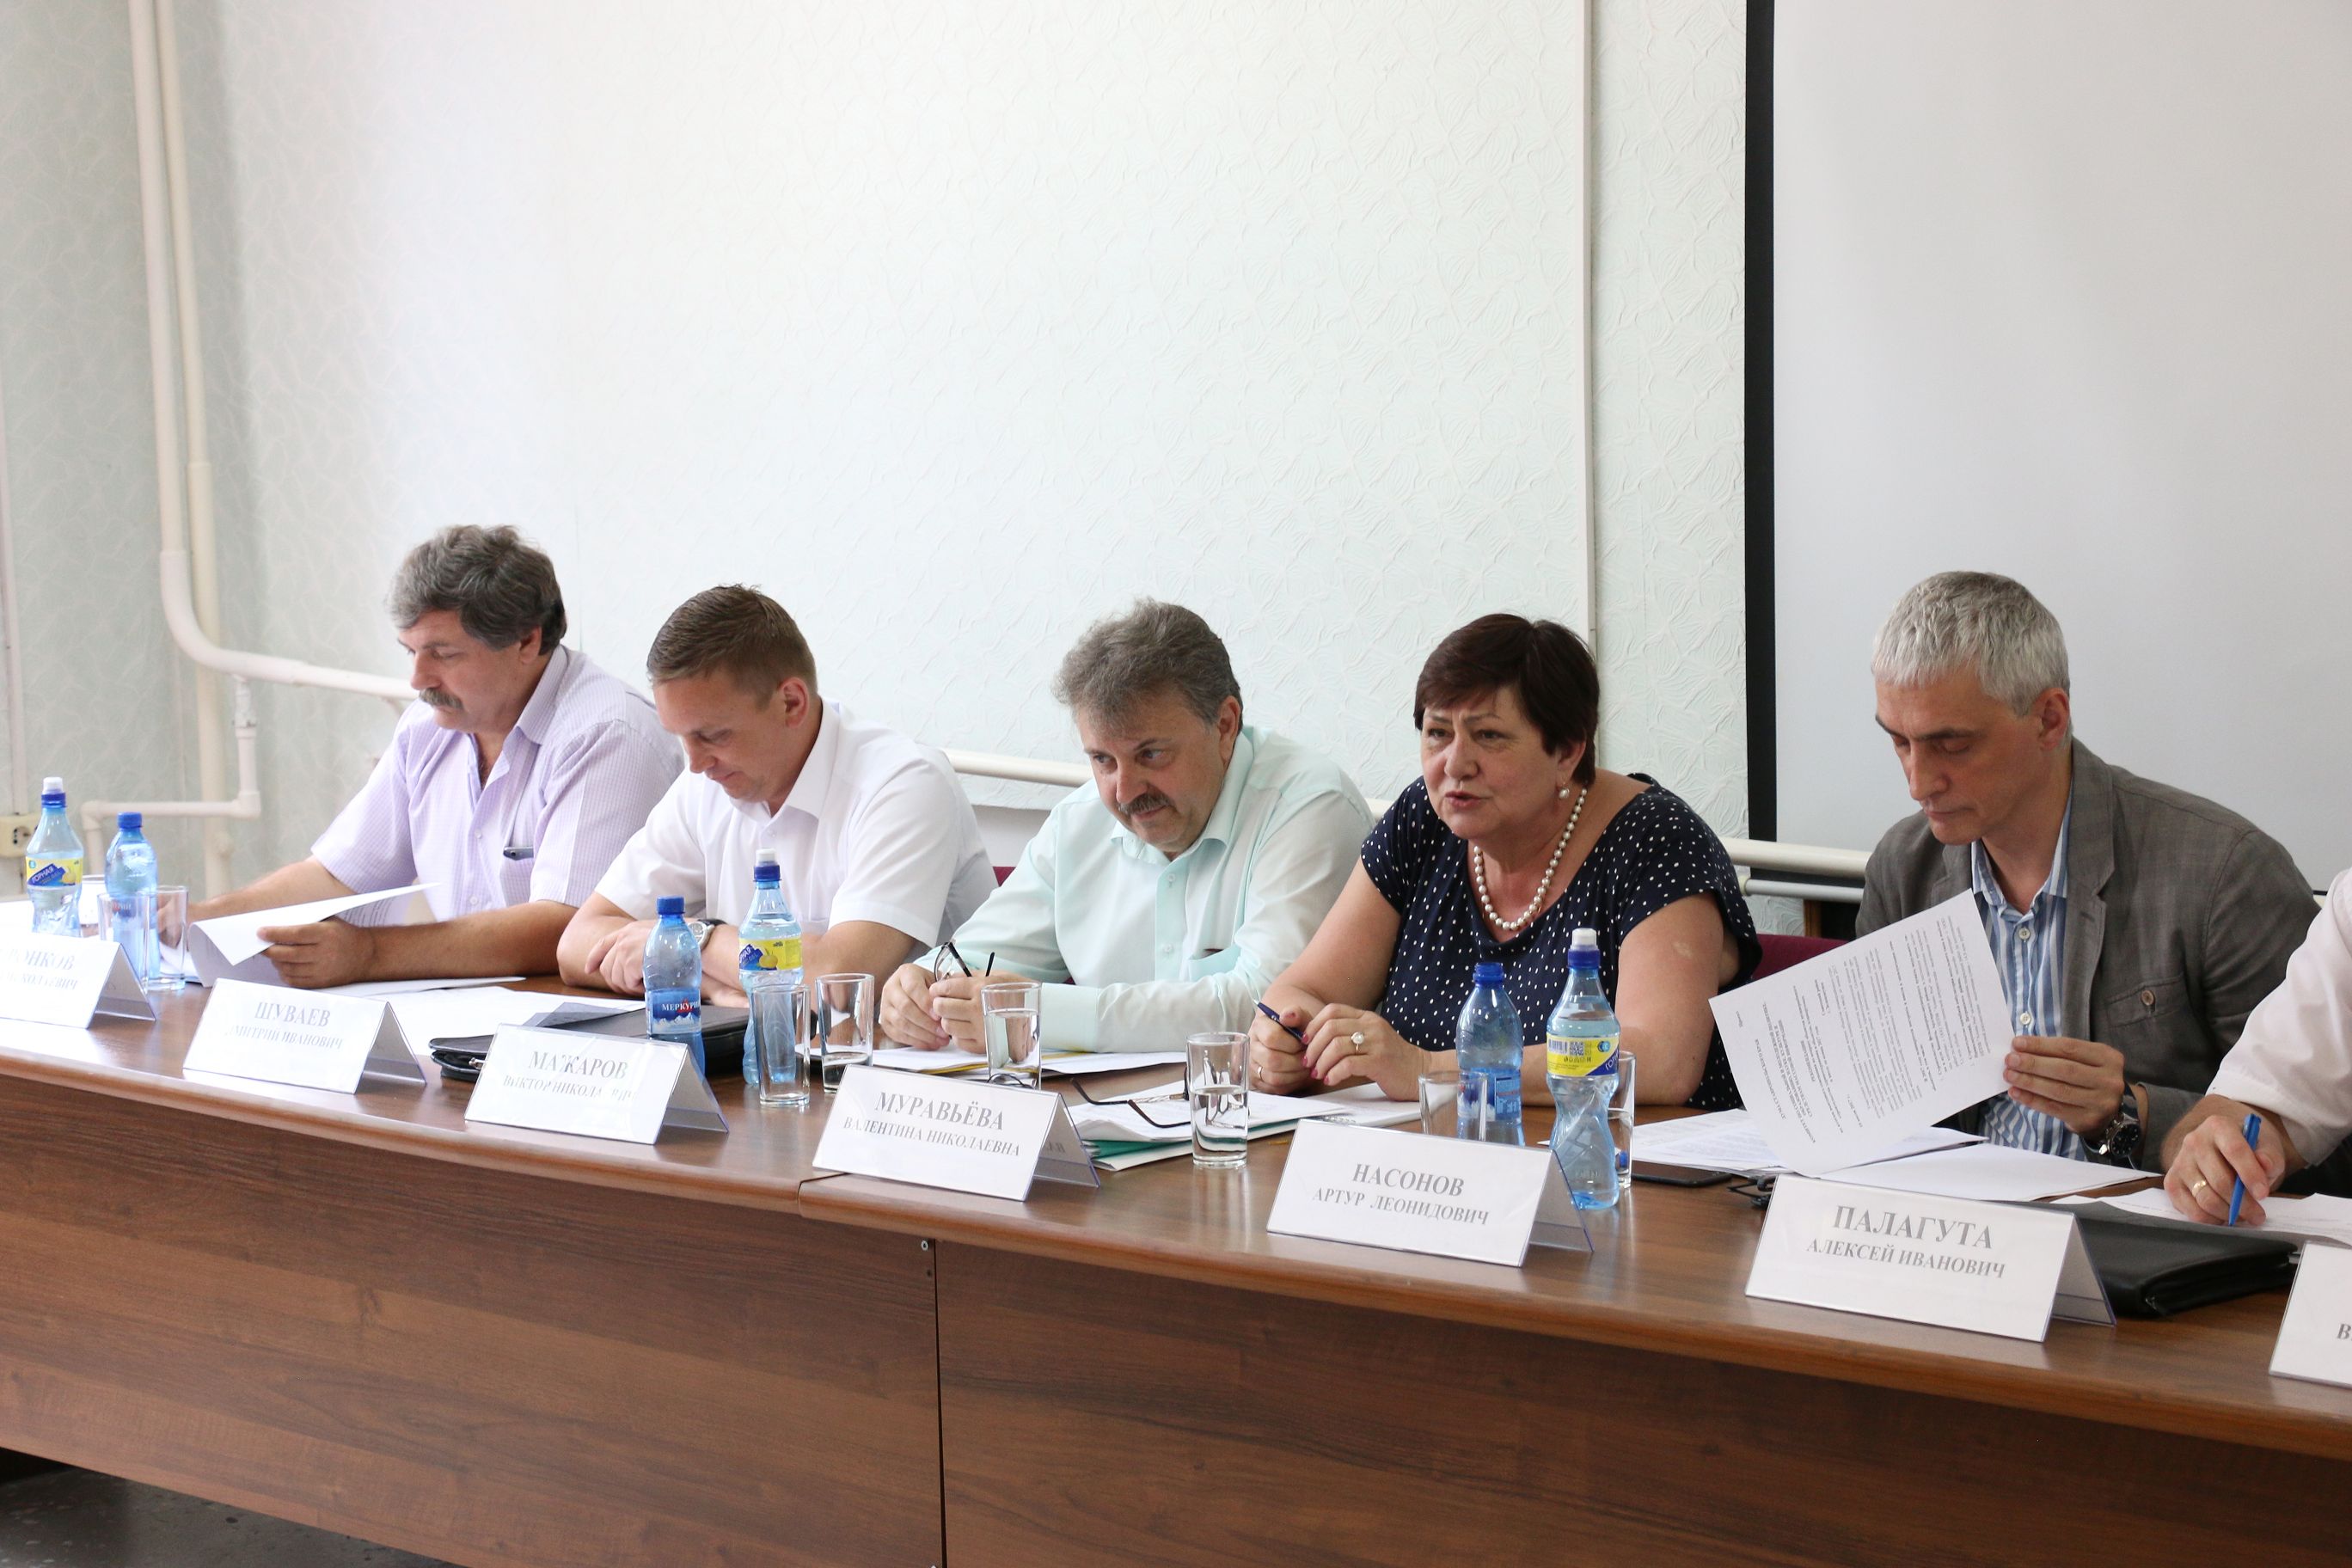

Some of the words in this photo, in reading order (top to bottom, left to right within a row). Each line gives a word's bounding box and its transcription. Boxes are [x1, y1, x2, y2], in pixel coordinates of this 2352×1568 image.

[254, 1001, 331, 1027] ШУВАЕВ
[224, 1024, 281, 1041] МИТРИЙ
[282, 1031, 343, 1050] ИВАНОВИЧ
[528, 1050, 629, 1080] МАЖАРОВ
[503, 1075, 551, 1092] ВИКТОР
[874, 1092, 1004, 1130] МУРАВЬЁВА
[843, 1117, 922, 1141] ВАЛЕНТИНА
[926, 1130, 1020, 1156] НИКОЛАЕВНА
[1352, 1163, 1465, 1197] НАСОНОВ
[1312, 1186, 1365, 1206] АРТУР
[1370, 1195, 1491, 1226] ЛЕОНИДОВИЧ
[1833, 1205, 1993, 1249] ПАЛАГУТА
[1807, 1238, 1895, 1264] АЛЕКСЕЙ
[1897, 1249, 2006, 1279] ИВАНОВИЧ
